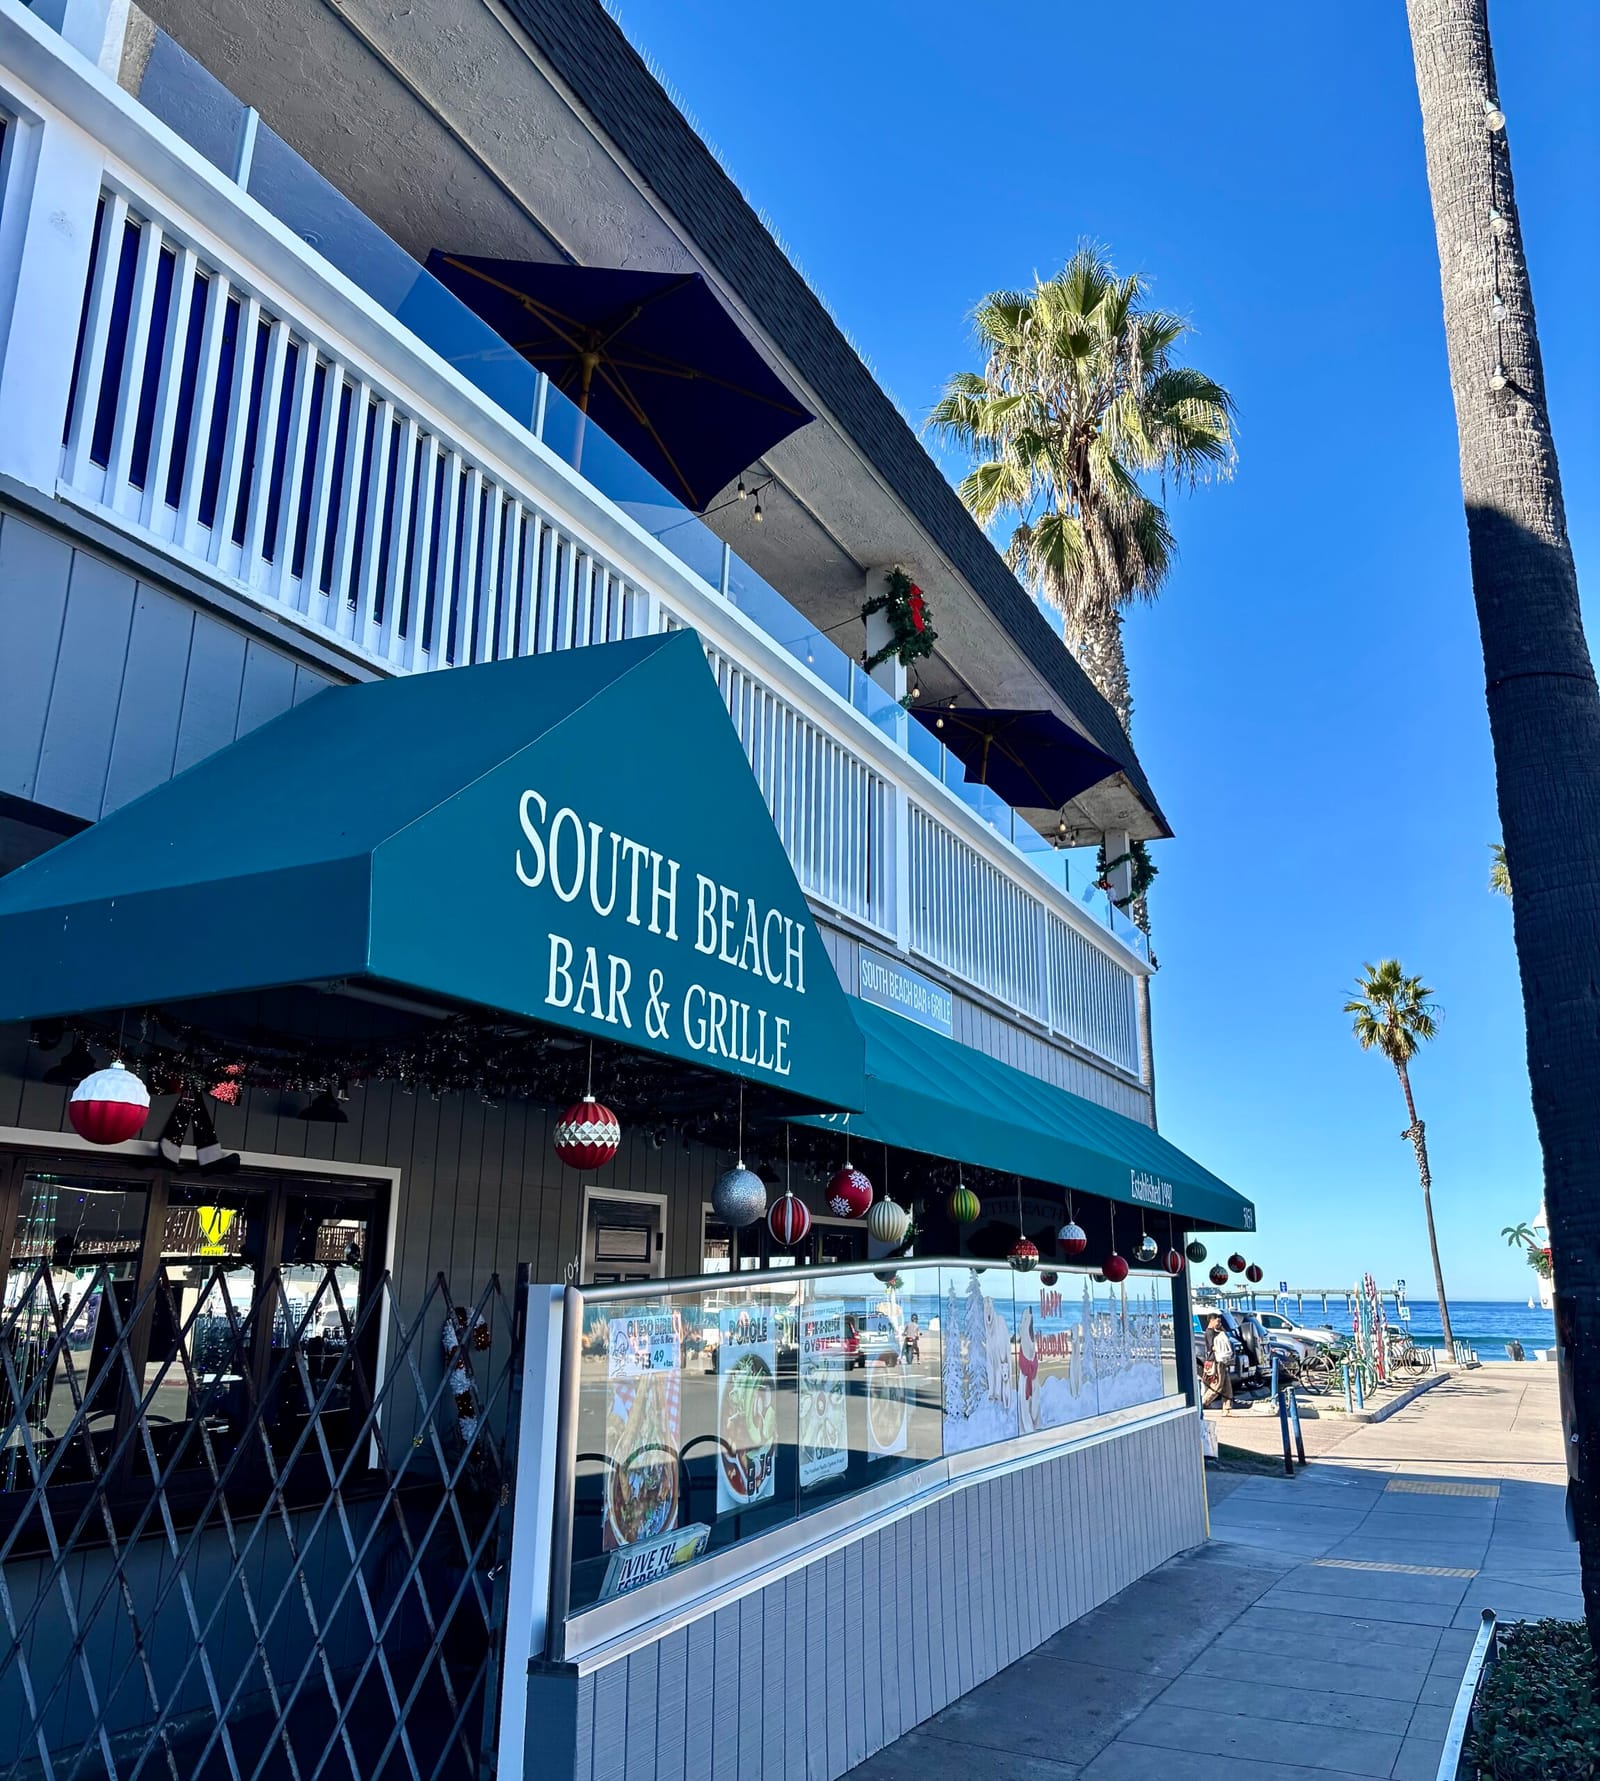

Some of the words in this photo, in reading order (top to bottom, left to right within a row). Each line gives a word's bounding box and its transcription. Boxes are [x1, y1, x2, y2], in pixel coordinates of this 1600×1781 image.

[516, 789, 680, 941] SOUTH
[694, 873, 806, 994] BEACH
[544, 933, 632, 1029] BAR
[645, 968, 670, 1040] &
[683, 984, 791, 1076] GRILLE
[862, 959, 888, 995] SOUTH
[889, 971, 913, 1007] BEACH
[913, 984, 927, 1014] BAR
[931, 993, 950, 1025] GRILLE
[1130, 1169, 1161, 1205] Established
[1040, 1288, 1062, 1319] HAPPY
